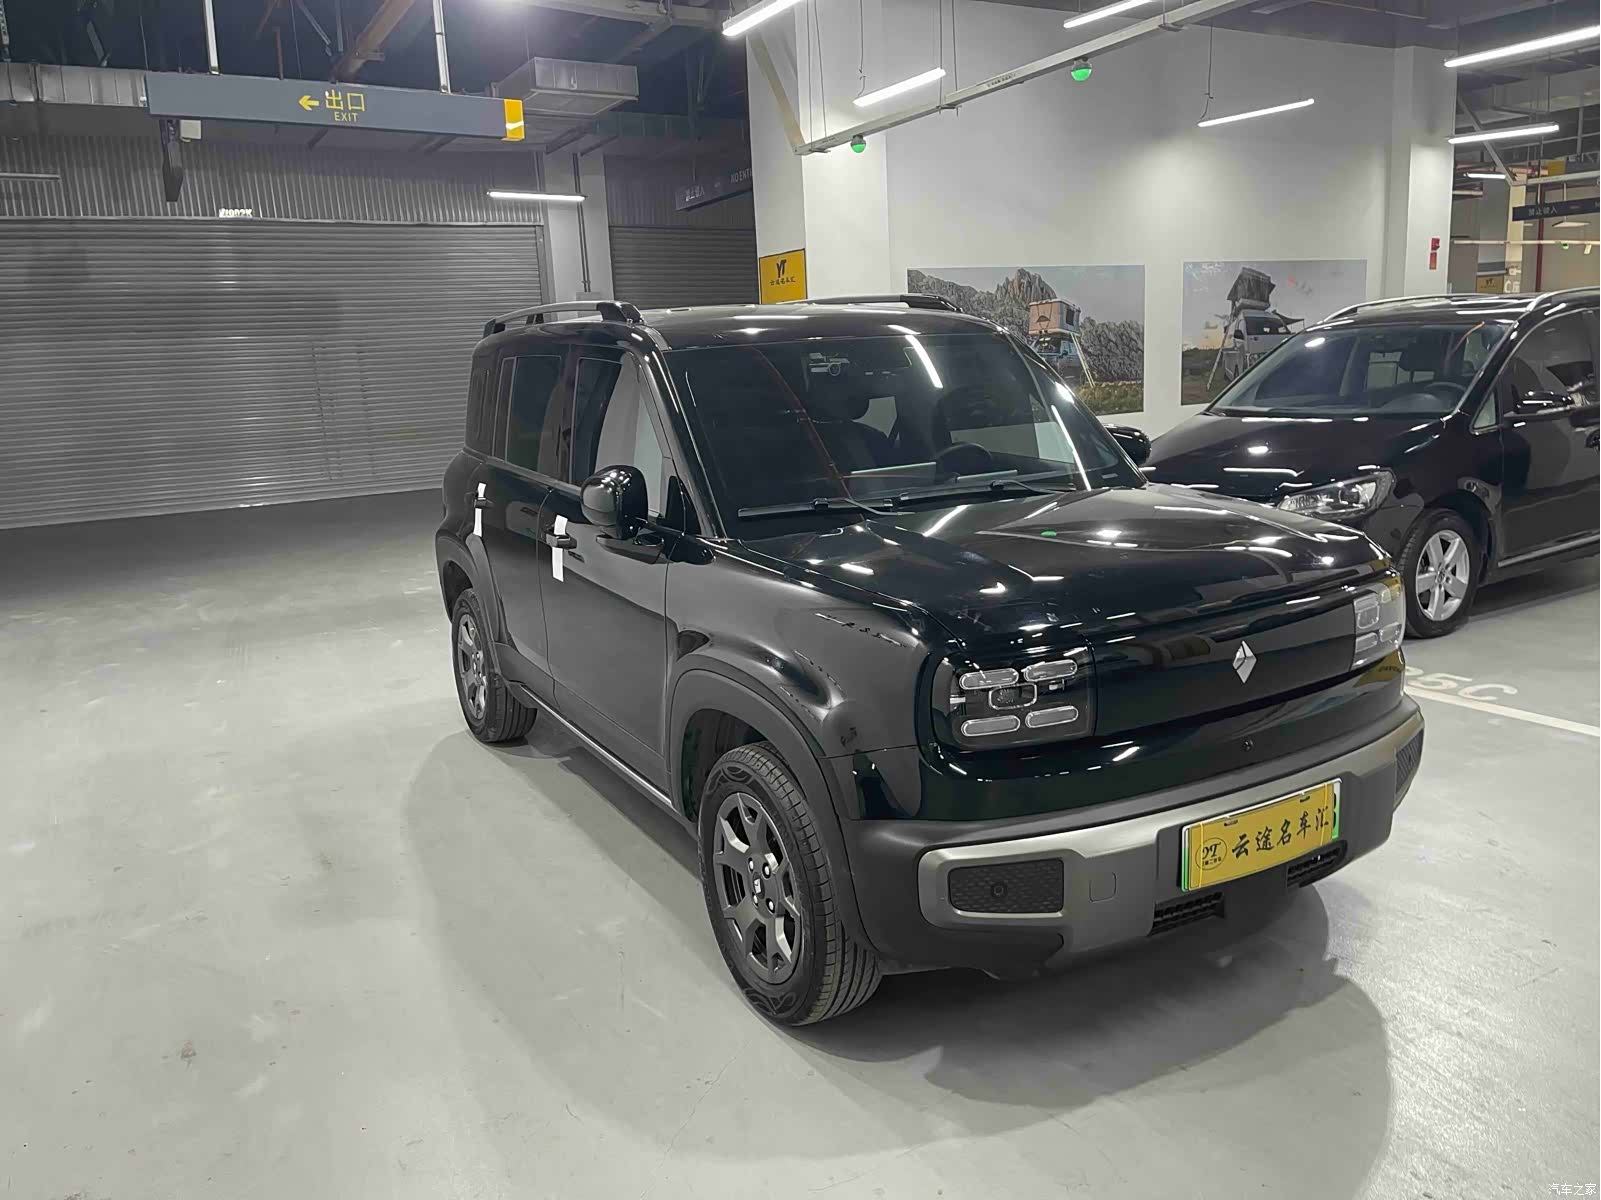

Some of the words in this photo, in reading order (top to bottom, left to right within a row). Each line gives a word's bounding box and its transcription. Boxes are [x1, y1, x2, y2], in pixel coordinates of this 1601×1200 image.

[325, 89, 365, 112] 出口
[334, 111, 358, 122] EXIT
[1232, 806, 1329, 859] 云途名车汇
